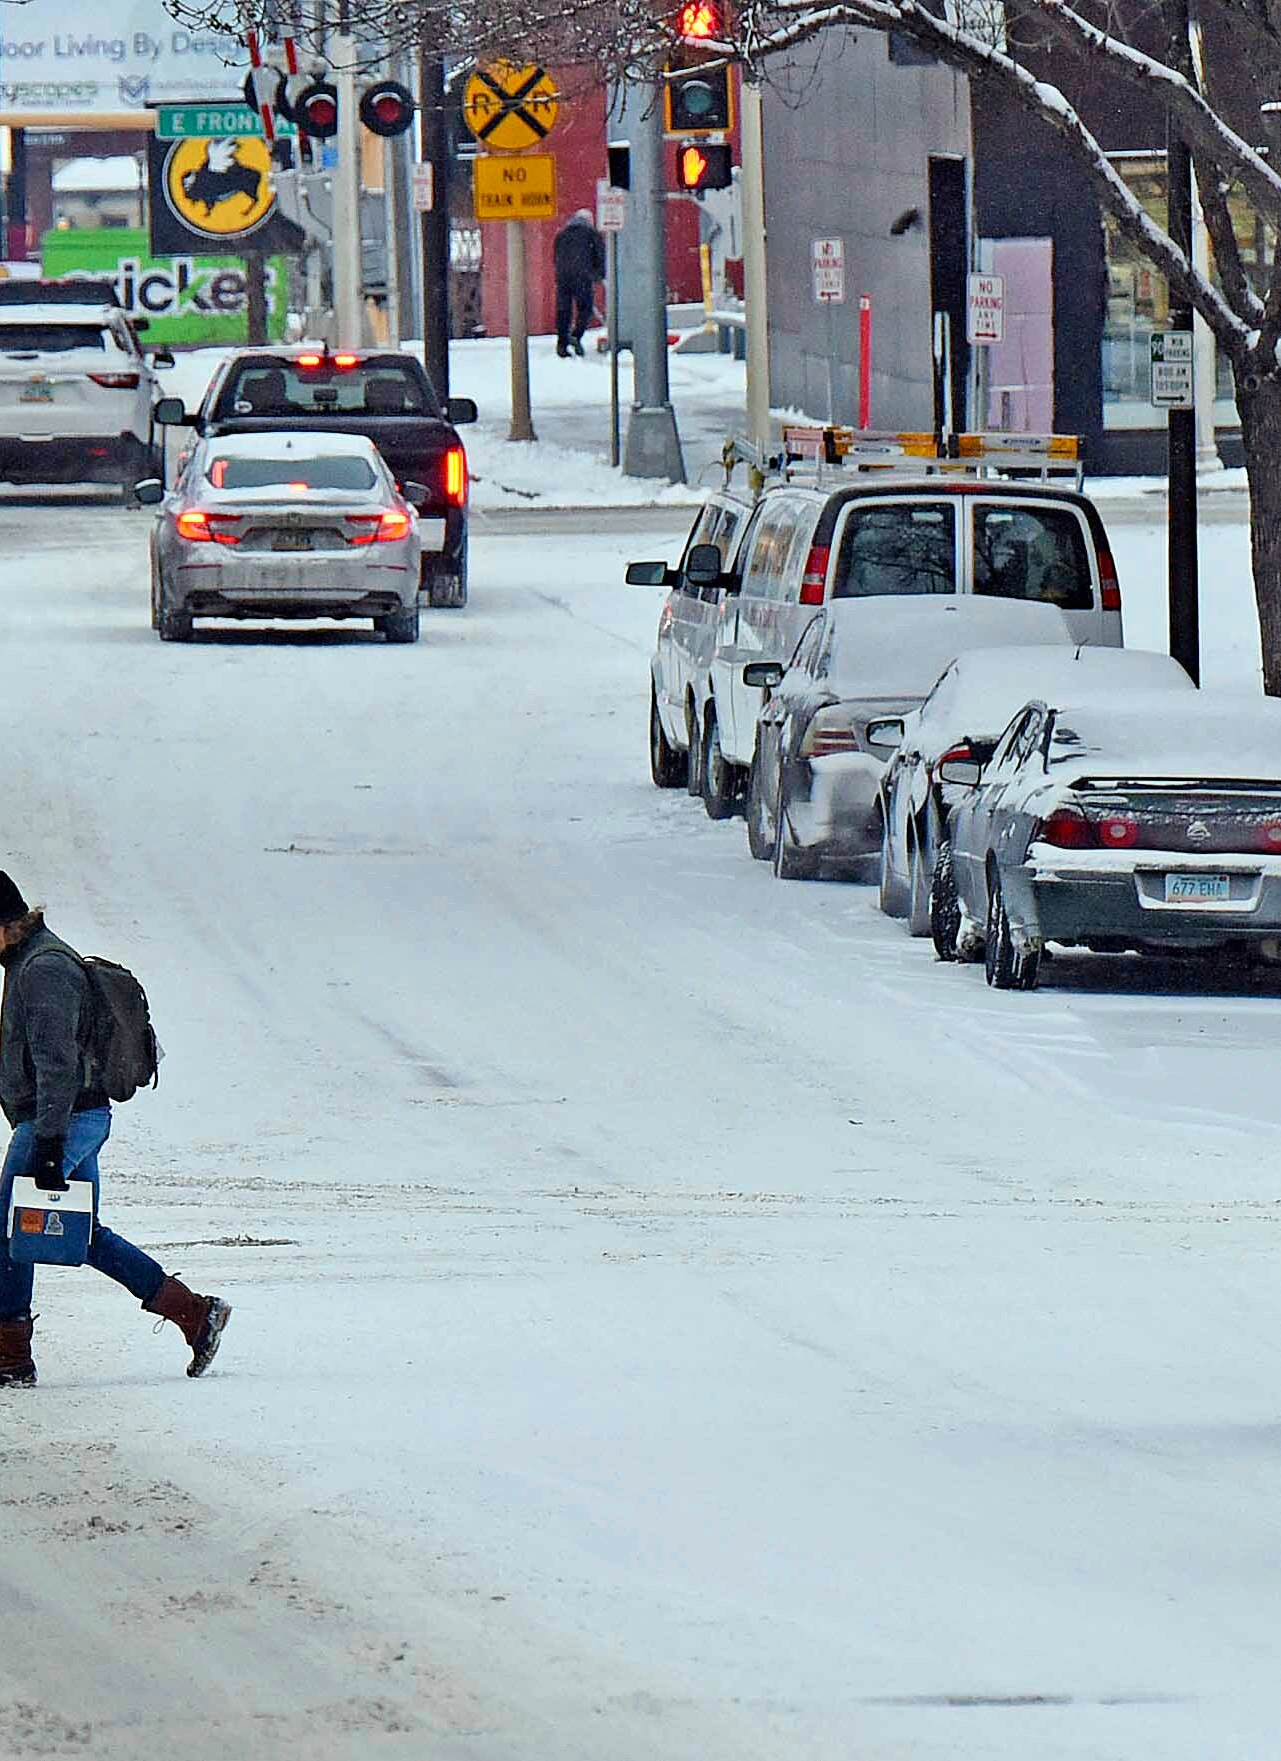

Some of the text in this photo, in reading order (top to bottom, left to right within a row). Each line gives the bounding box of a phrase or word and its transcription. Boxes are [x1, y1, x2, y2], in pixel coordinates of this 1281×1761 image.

[53, 34, 126, 62] Living
[134, 32, 159, 62] By
[172, 113, 185, 133] E
[503, 167, 527, 182] NO
[69, 257, 276, 315] icke
[979, 281, 992, 294] NO
[1173, 881, 1196, 896] 677
